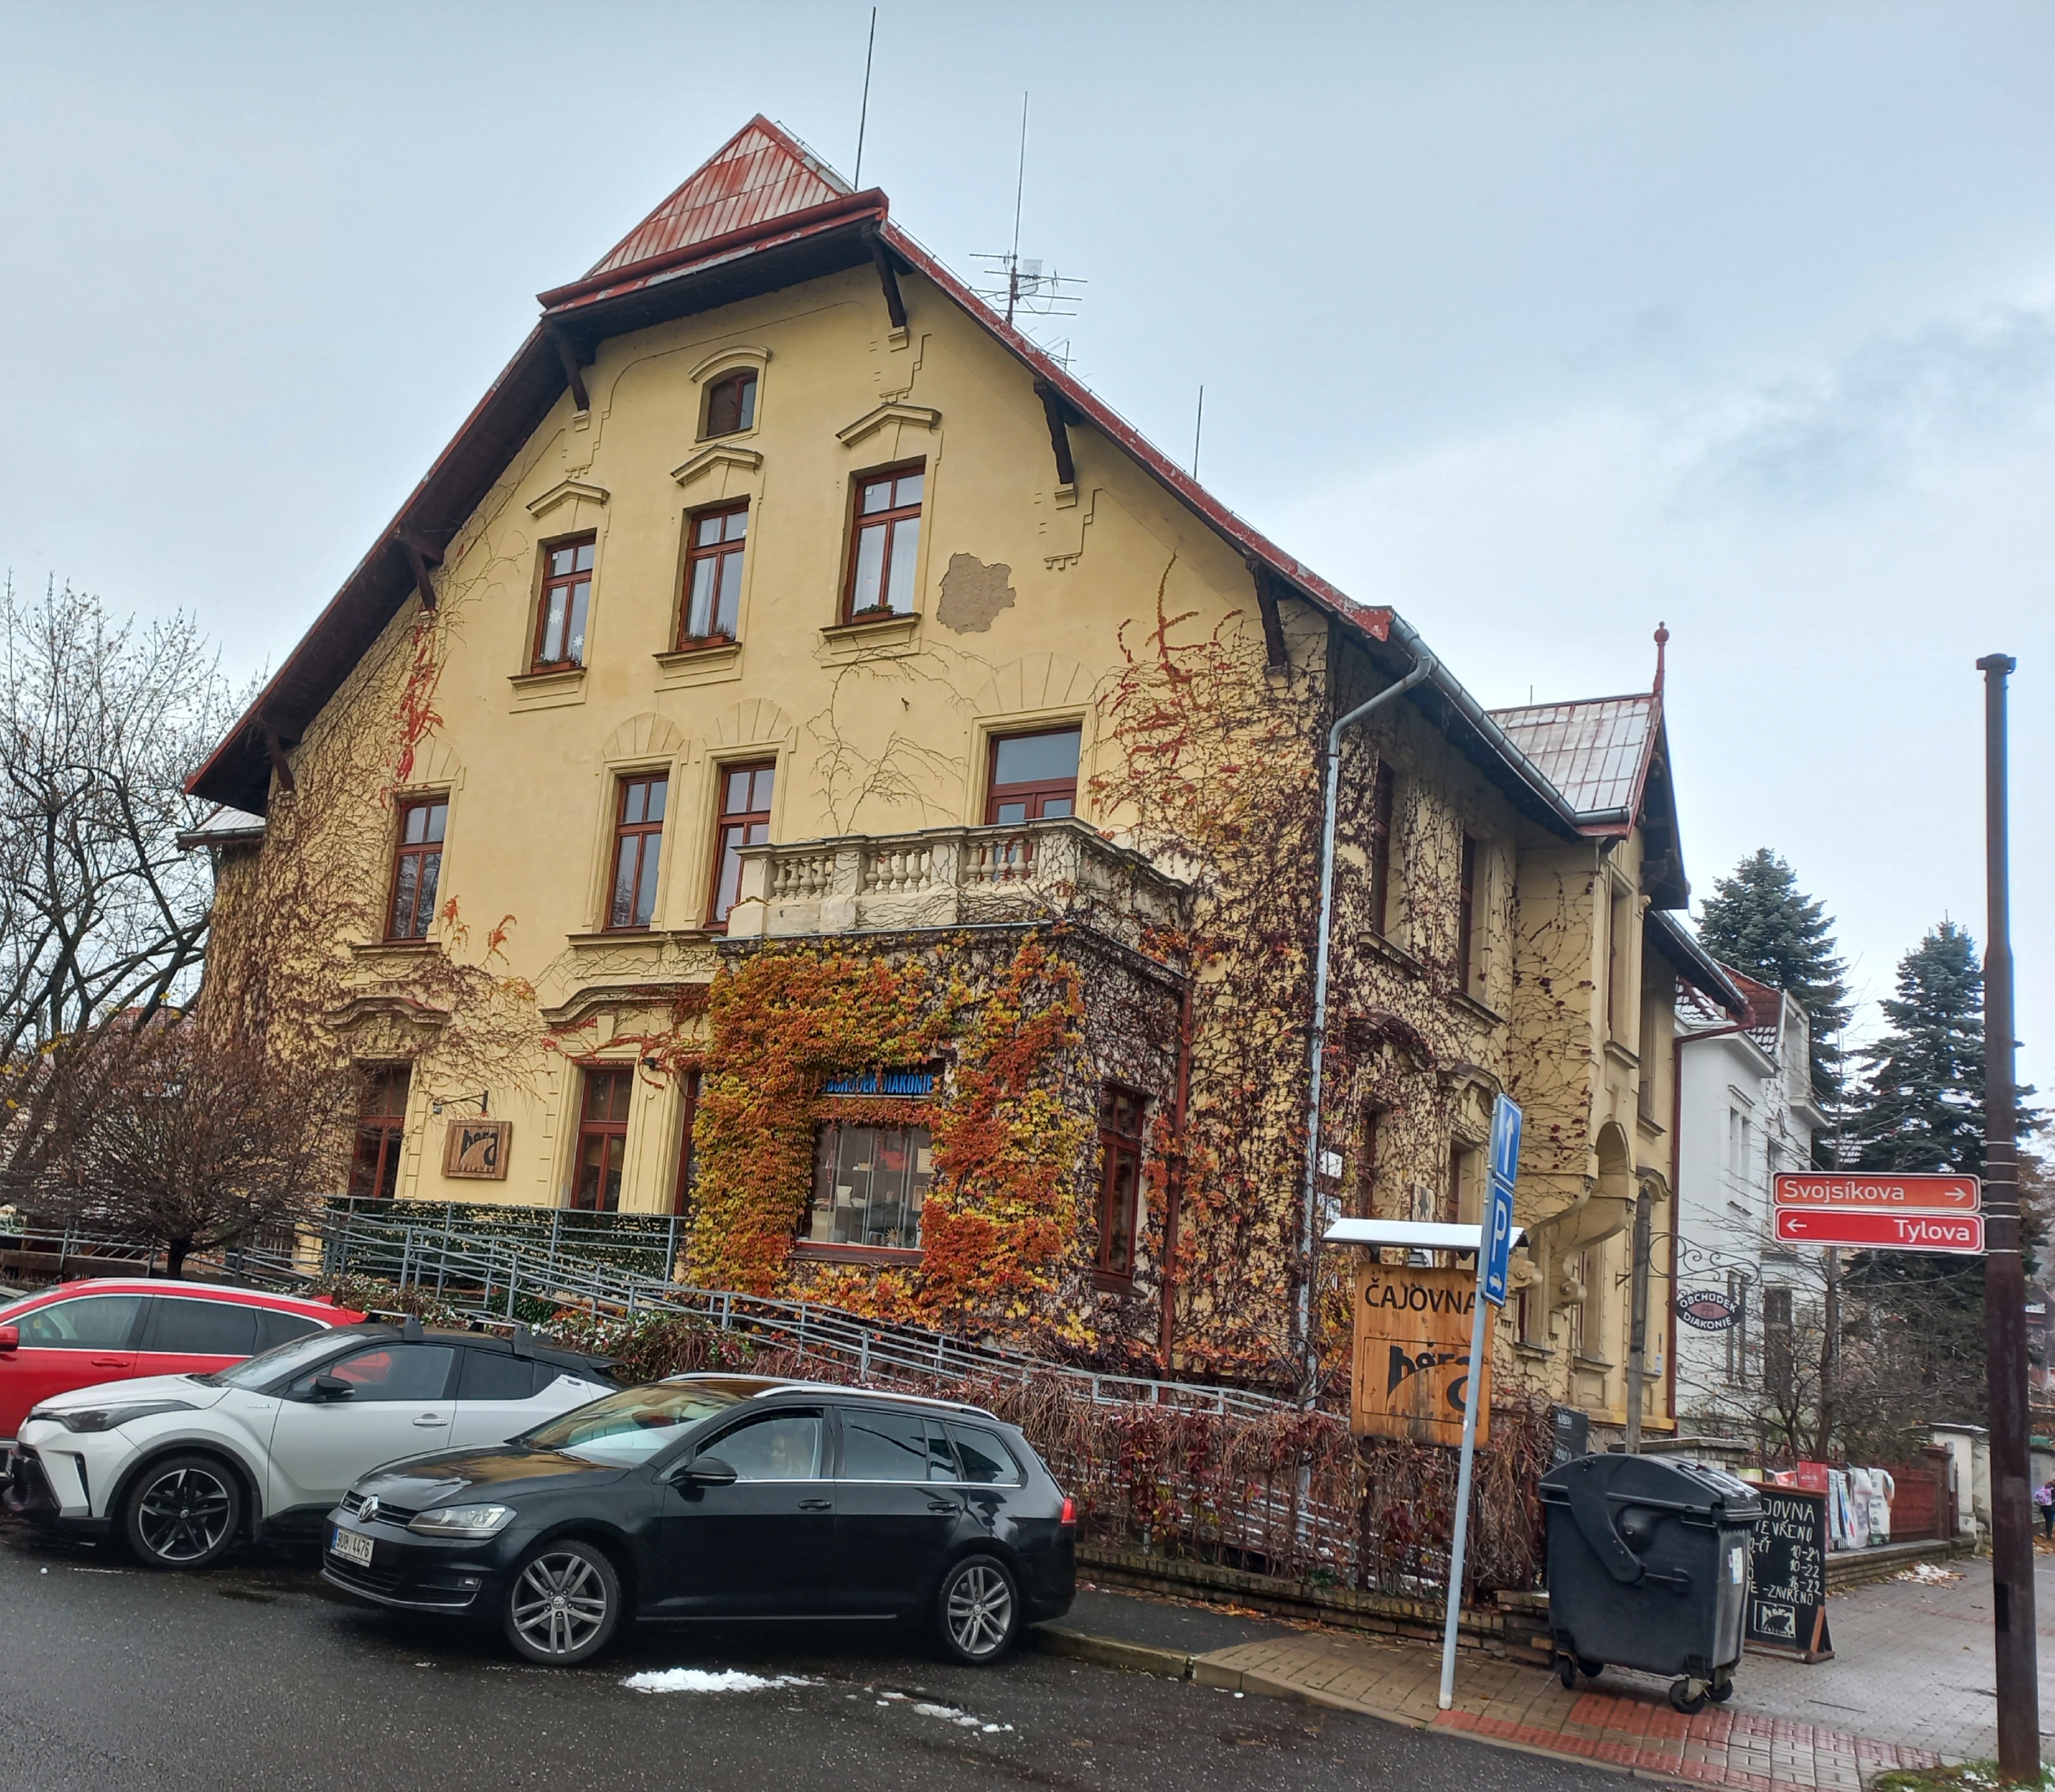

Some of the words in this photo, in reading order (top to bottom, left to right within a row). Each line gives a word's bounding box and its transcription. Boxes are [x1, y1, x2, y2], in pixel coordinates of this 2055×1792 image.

[1784, 1180, 1904, 1203] Svojsíkova
[1894, 1218, 1970, 1243] Tylova
[1365, 1277, 1476, 1315] ČAJOVNA
[1683, 1312, 1732, 1329] DIAKONIE
[1763, 1498, 1815, 1523] JOVNA
[1756, 1519, 1813, 1542] TEVŘENO
[1749, 1536, 1772, 1553] O-ČT
